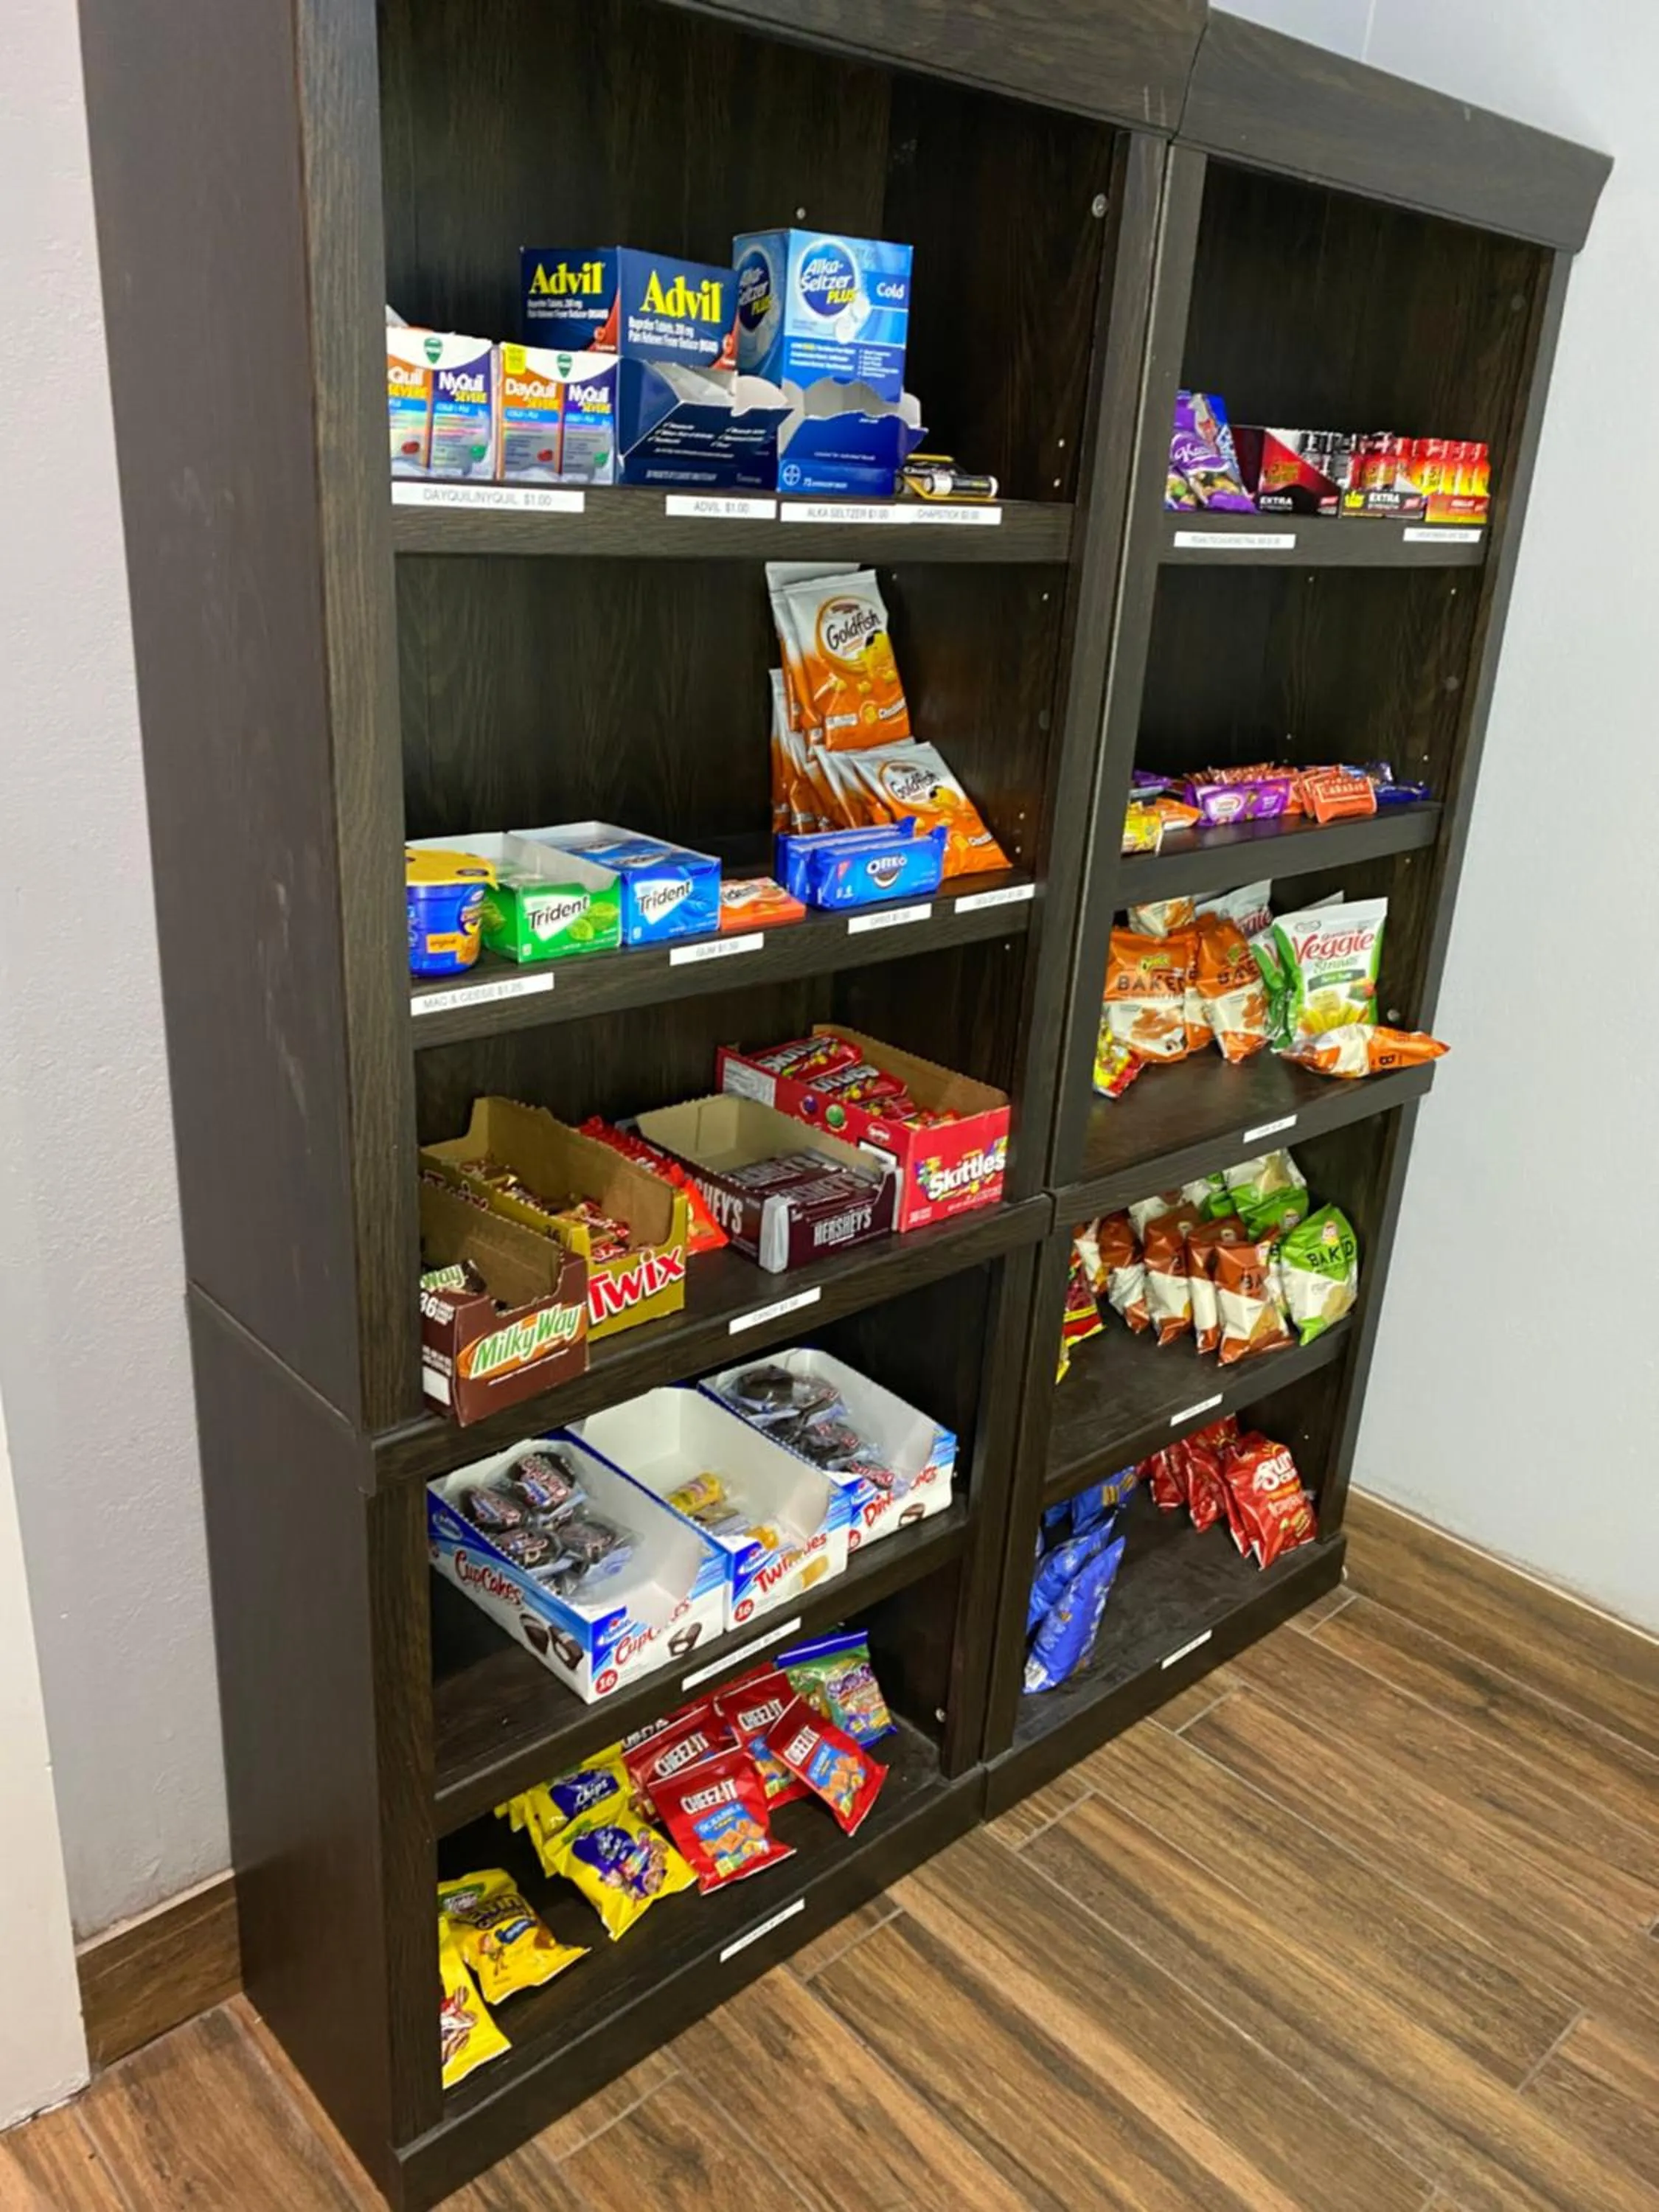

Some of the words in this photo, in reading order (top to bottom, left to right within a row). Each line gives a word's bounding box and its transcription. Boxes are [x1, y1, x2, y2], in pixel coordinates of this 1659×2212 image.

[529, 262, 602, 295] Advil
[802, 259, 844, 275] Alka-
[799, 275, 852, 292] Seltzer
[876, 282, 905, 299] Cold
[639, 270, 723, 323] Advil
[826, 288, 857, 305] PLUS
[389, 366, 425, 385] Quil
[439, 371, 485, 395] NyQuil
[504, 377, 557, 401] DayQuil
[568, 384, 610, 406] NyQuil
[693, 501, 721, 512] ADVIL
[1259, 495, 1293, 505] EXTRA
[1368, 493, 1400, 503] EXTRA
[826, 609, 881, 651] Goldfish
[866, 853, 908, 875] OREO
[637, 881, 690, 913] Trident
[527, 895, 588, 930] Trident
[1291, 932, 1374, 965] Veggie
[927, 1152, 1006, 1200] Skittles
[813, 1207, 873, 1248] HERSHEY'S
[1306, 1239, 1354, 1268] BAKD
[588, 1245, 686, 1326] Twix
[454, 1548, 521, 1606] CupCakes
[737, 1603, 753, 1618] 16
[599, 1674, 616, 1688] 16
